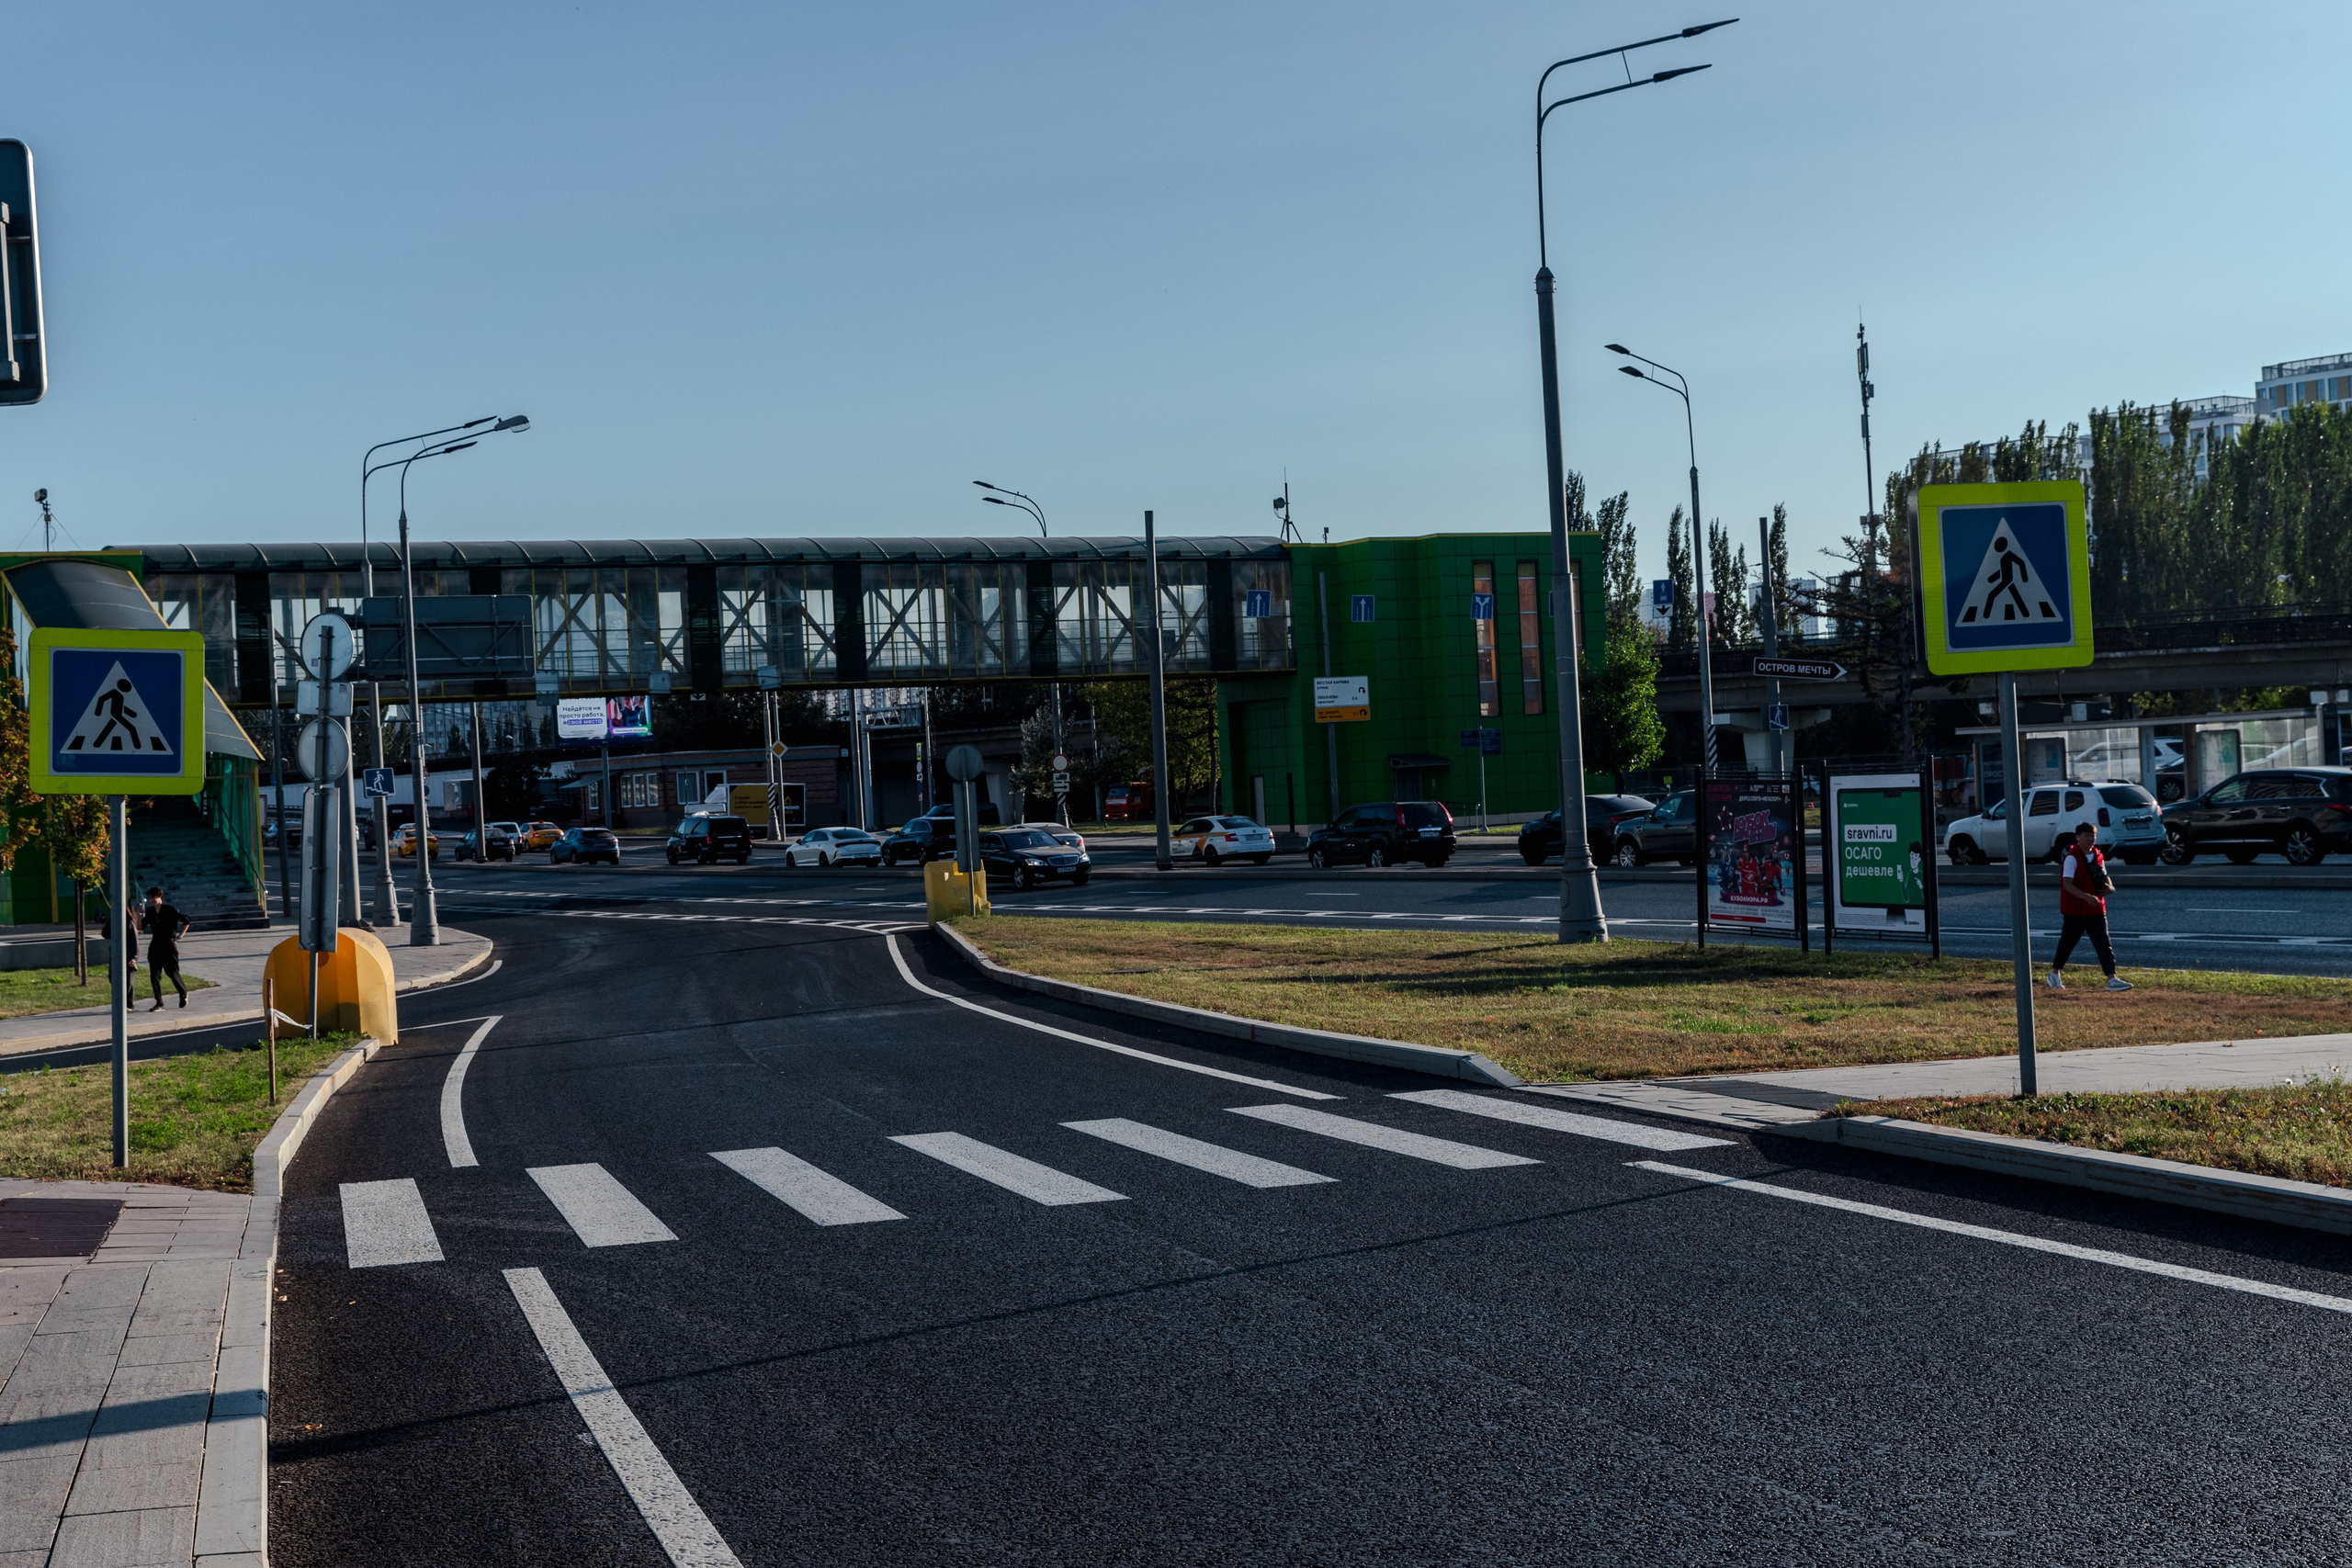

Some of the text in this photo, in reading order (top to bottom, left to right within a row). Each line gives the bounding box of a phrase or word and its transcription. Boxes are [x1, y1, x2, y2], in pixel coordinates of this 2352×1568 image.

[1758, 662, 1831, 675] ОСТРОВ МЕЧТЫ
[1734, 809, 1770, 833] КУБОК
[1847, 826, 1893, 840] sravni.ru
[1845, 846, 1883, 860] ОСАГО
[1846, 866, 1894, 878] дешевле
